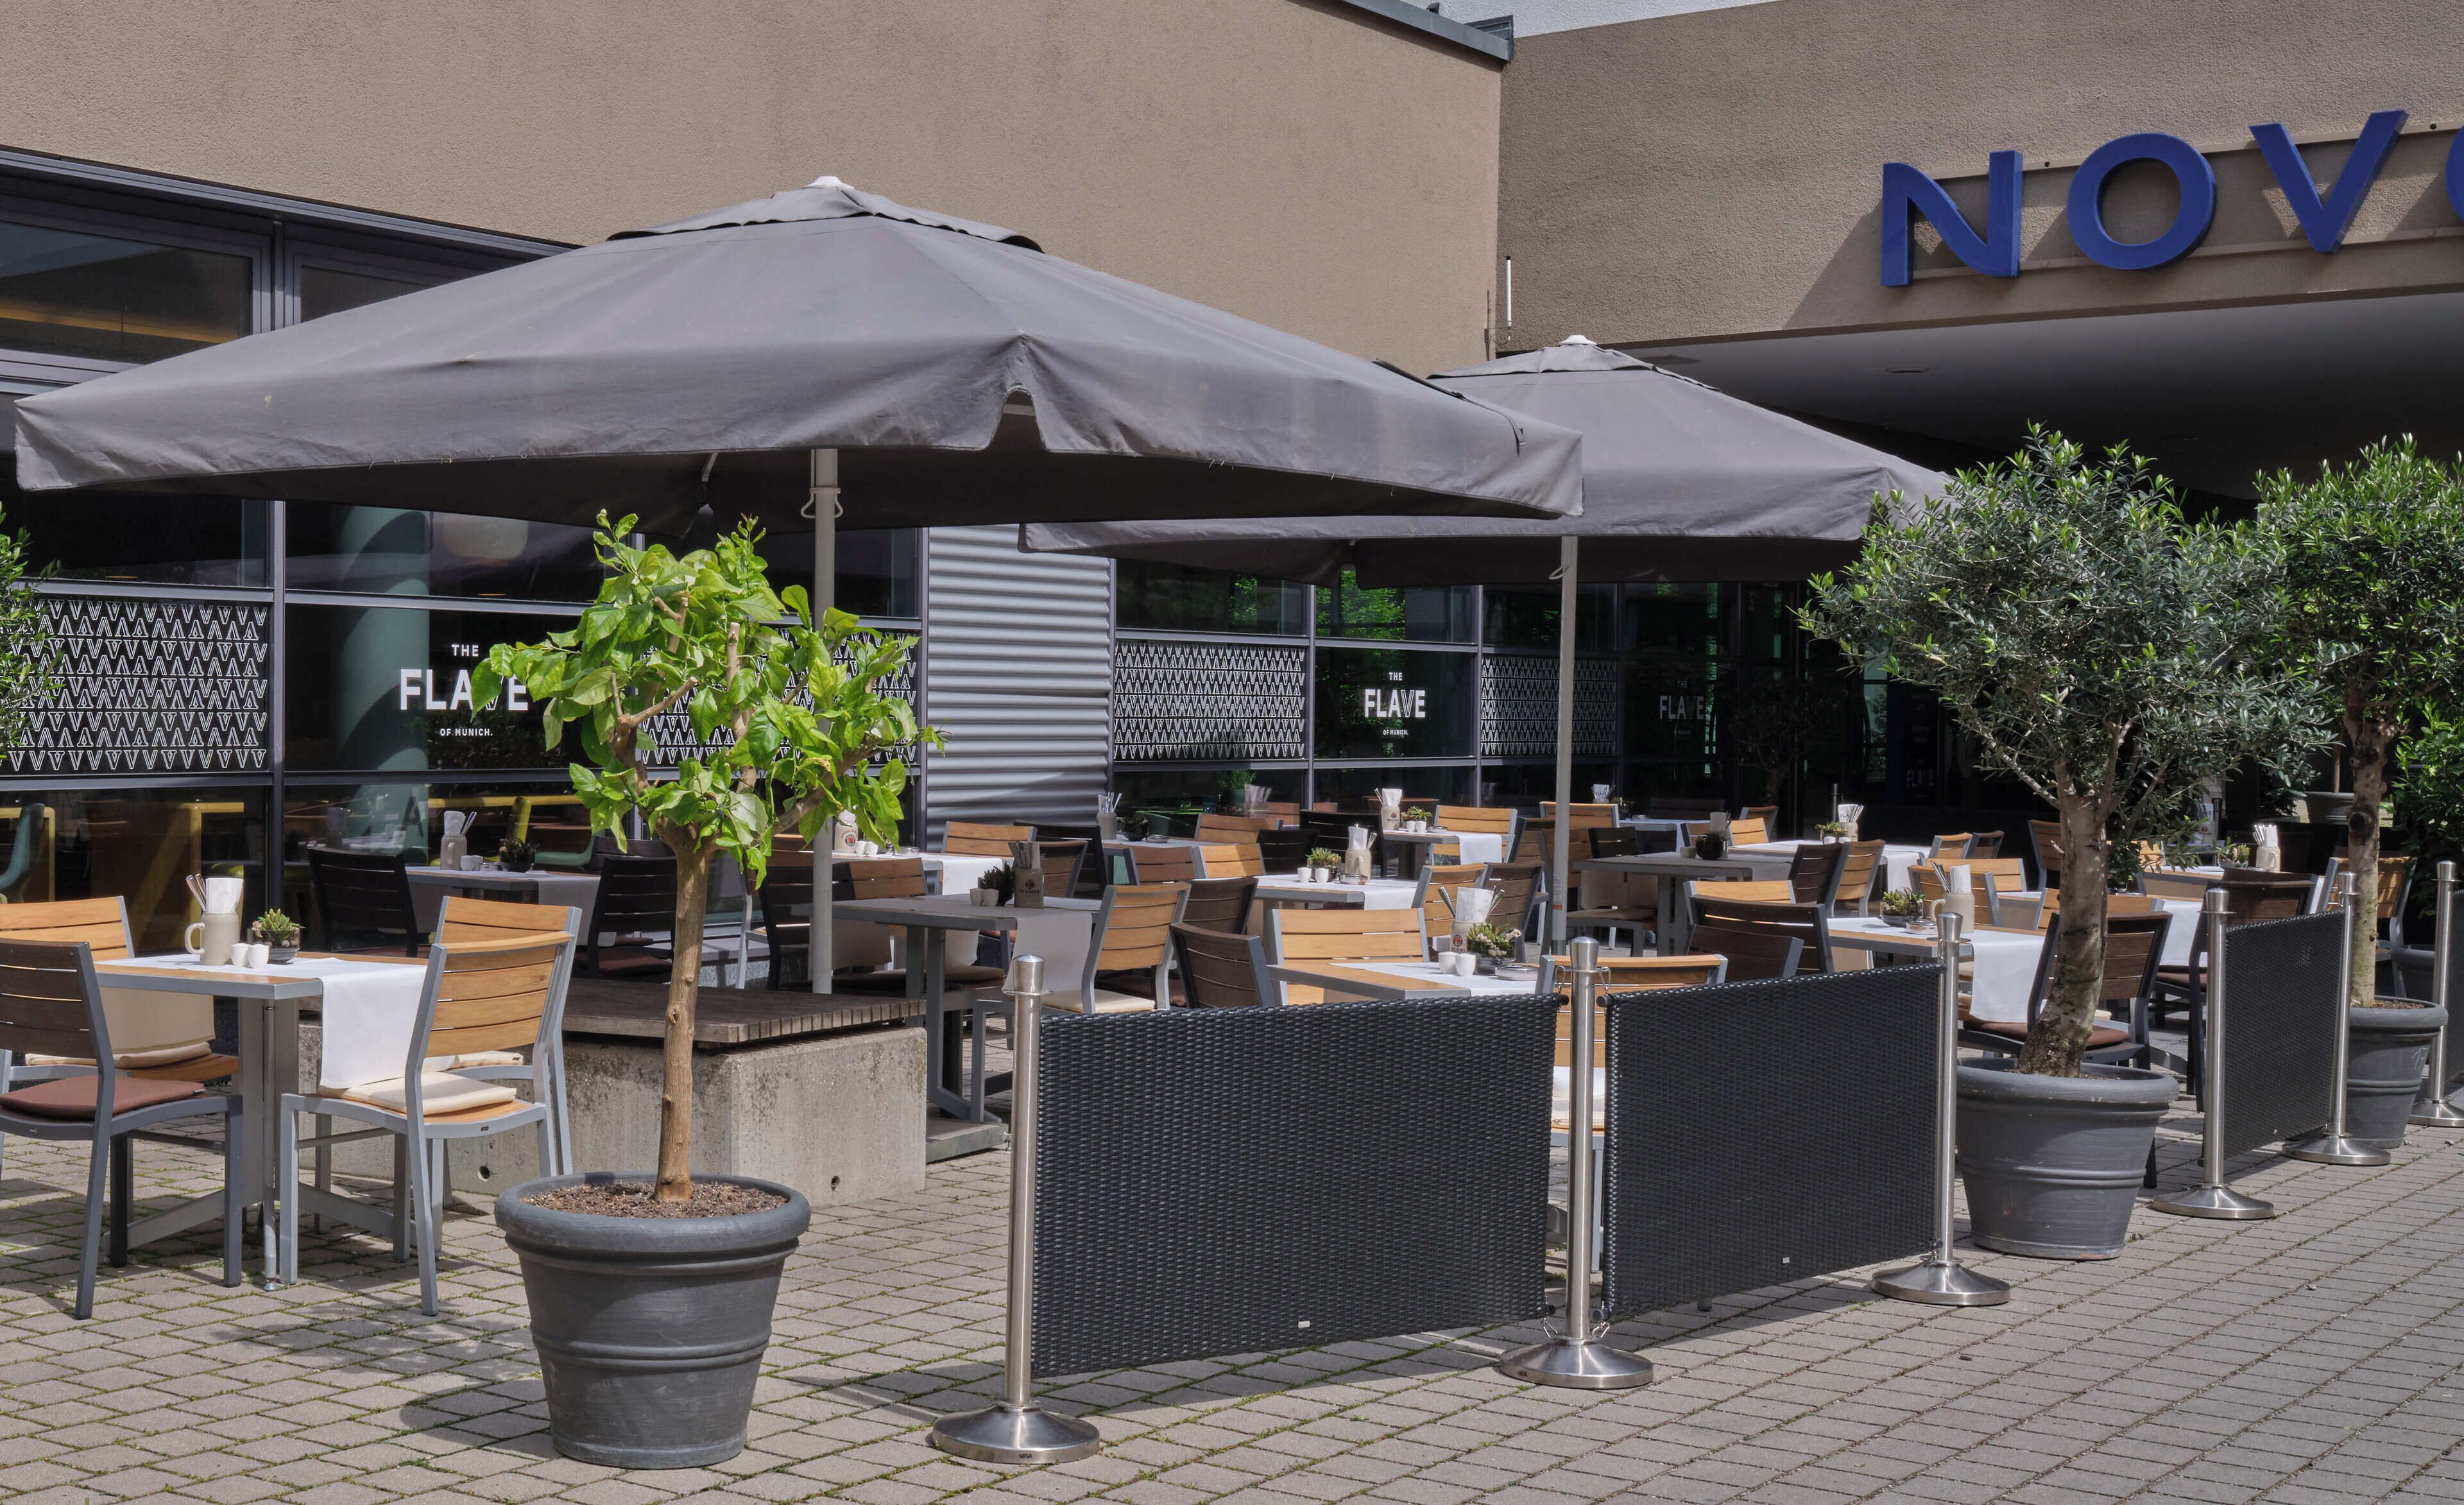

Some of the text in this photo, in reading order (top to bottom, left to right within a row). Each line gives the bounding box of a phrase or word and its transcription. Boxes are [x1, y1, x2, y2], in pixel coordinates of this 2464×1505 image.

[1881, 110, 2464, 288] NOV
[451, 644, 479, 657] THE
[1389, 672, 1403, 681] THE
[400, 669, 528, 710] FLAE
[1365, 689, 1426, 718] FLAVE
[440, 728, 493, 737] OF MUNICH.
